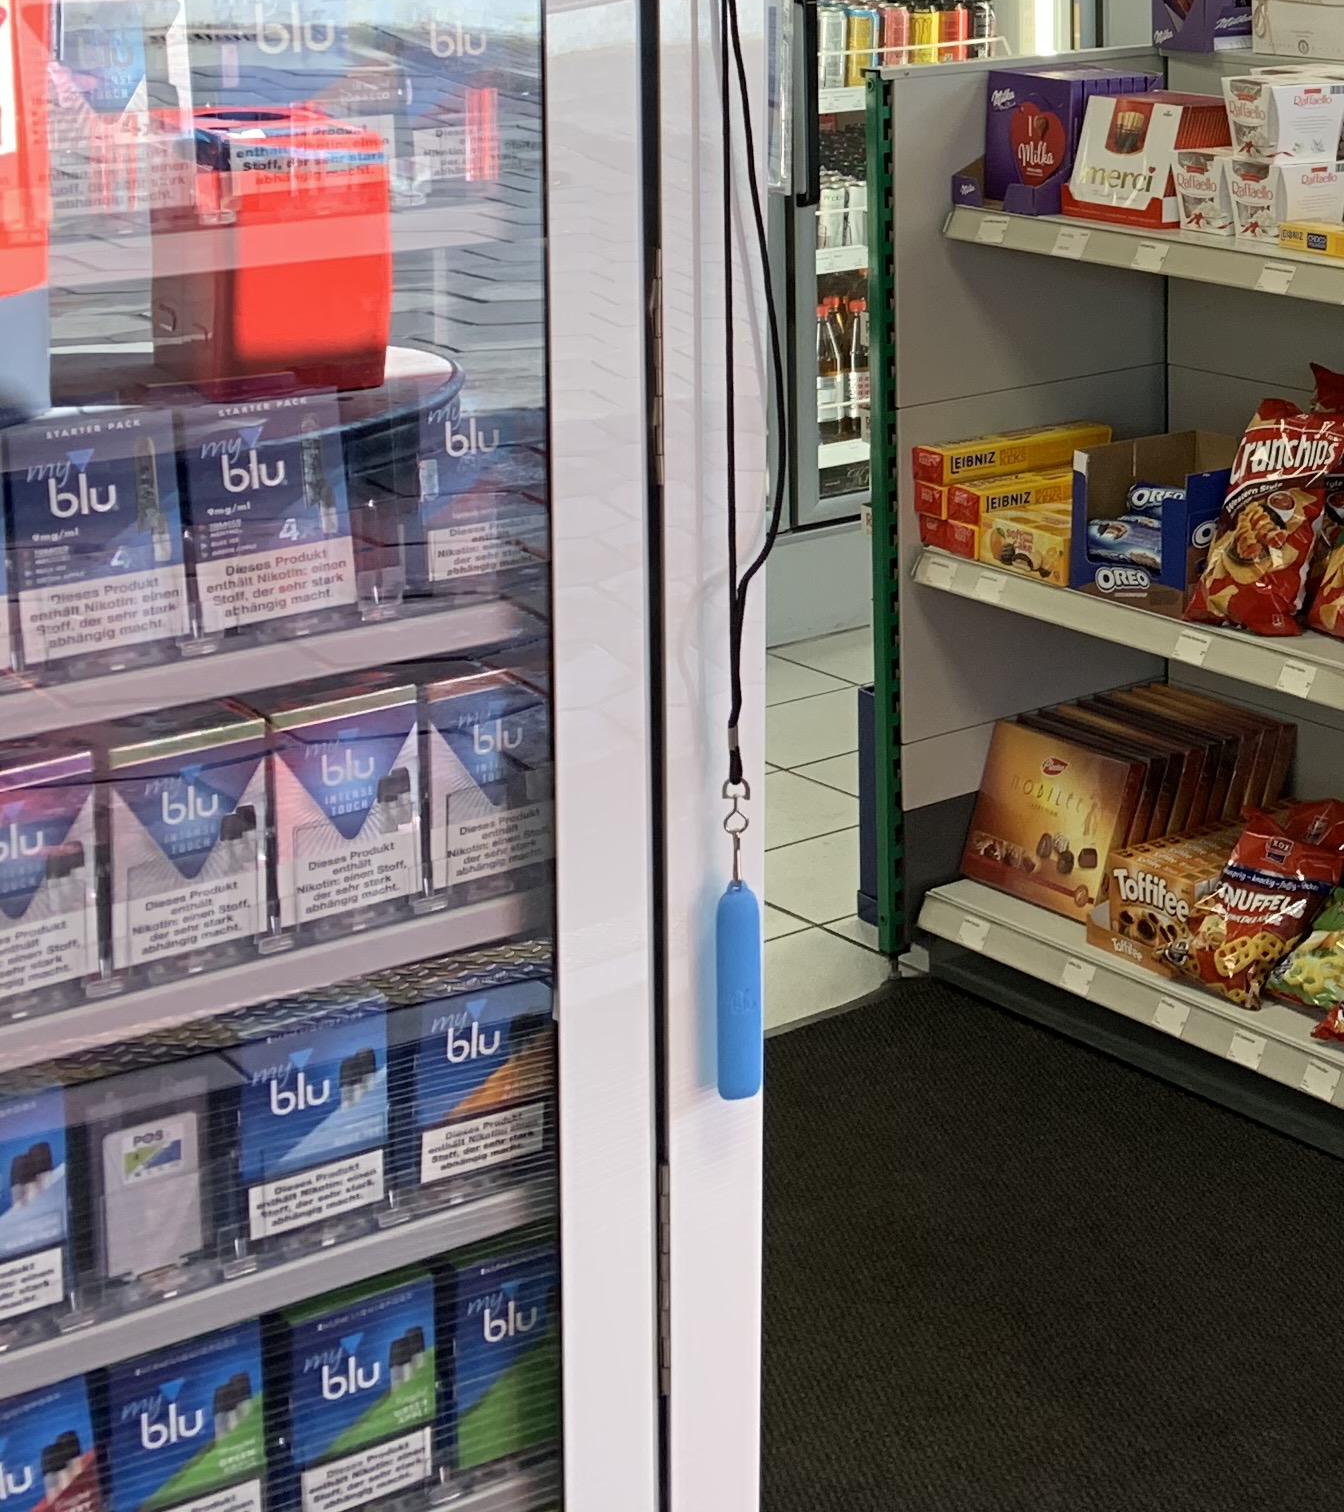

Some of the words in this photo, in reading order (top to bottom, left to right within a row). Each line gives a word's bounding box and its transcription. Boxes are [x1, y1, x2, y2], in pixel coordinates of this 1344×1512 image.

[1229, 101, 1265, 121] Raffaello
[1294, 95, 1332, 108] Raffaello
[1017, 142, 1054, 166] Milka
[1089, 164, 1153, 193] merci
[218, 402, 271, 417] STARTER
[276, 398, 307, 409] PACK
[46, 424, 102, 439] STARTER
[108, 419, 141, 430] PACK
[221, 449, 285, 493] blu
[950, 451, 996, 474] LEIBNIZ
[49, 472, 117, 518] blu
[207, 502, 251, 517] 9mg/ml
[206, 577, 255, 594] enthält
[257, 565, 307, 585] Nikotin:
[310, 559, 347, 575] einen
[225, 560, 272, 577] Dieses
[274, 548, 328, 569] Produkt
[213, 591, 249, 607] Stoff,
[252, 587, 275, 600] der
[278, 580, 308, 594] sehr
[310, 571, 345, 587] stark
[1097, 568, 1149, 590] OREO
[224, 598, 287, 619] abhängig
[290, 588, 334, 605] macht.
[320, 748, 375, 787] blu
[331, 799, 368, 816] TOUCH
[1113, 868, 1189, 923] Toffifee
[270, 1072, 330, 1116] blu
